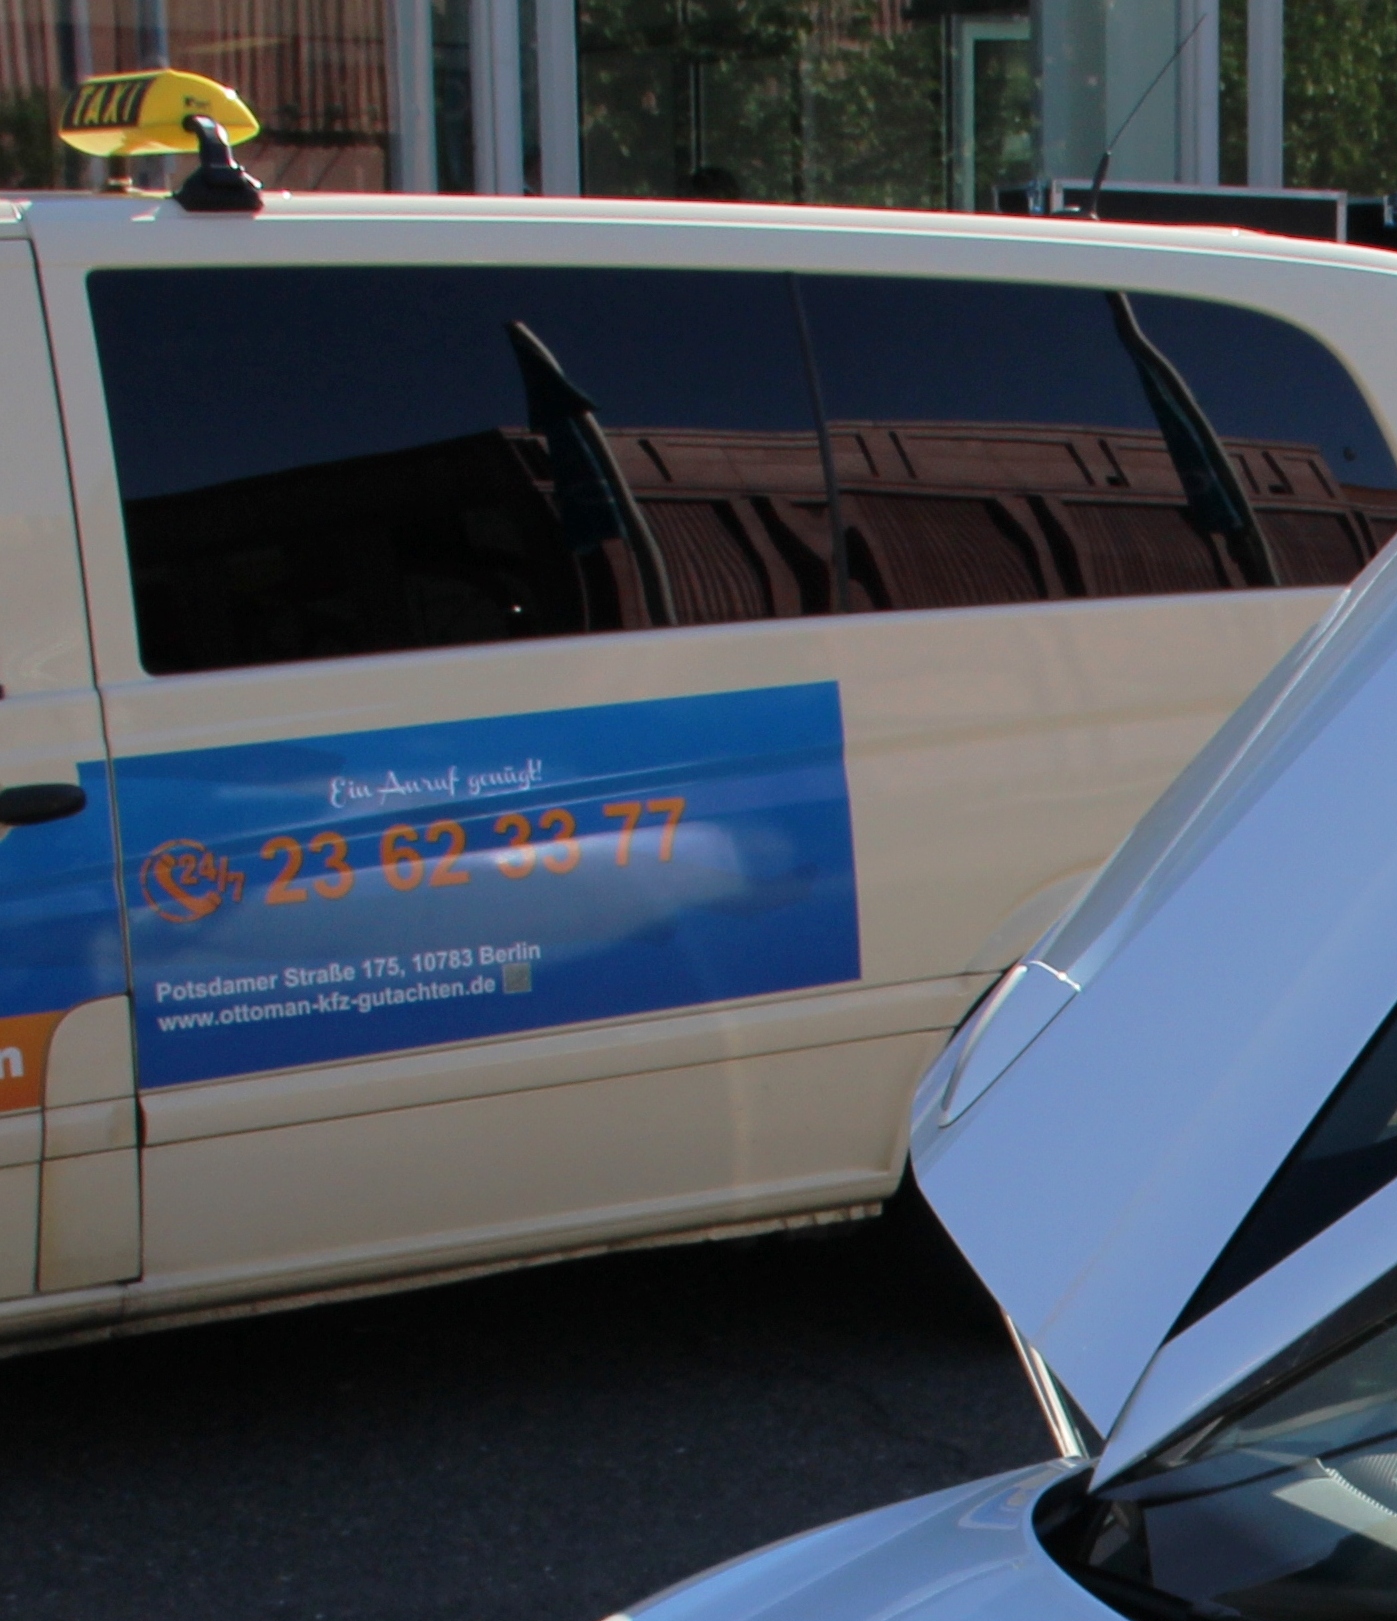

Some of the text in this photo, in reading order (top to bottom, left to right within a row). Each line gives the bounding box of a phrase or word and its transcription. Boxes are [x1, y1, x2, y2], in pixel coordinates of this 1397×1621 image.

[73, 82, 143, 128] TAXI
[329, 775, 372, 809] Ein
[377, 765, 461, 806] Anruf
[260, 796, 686, 906] 23 62 33 77
[155, 940, 542, 1004] Potsdamer Straße 175, 10783 Berlin
[156, 974, 496, 1033] www.ottoman-kfz-gutachten.de
